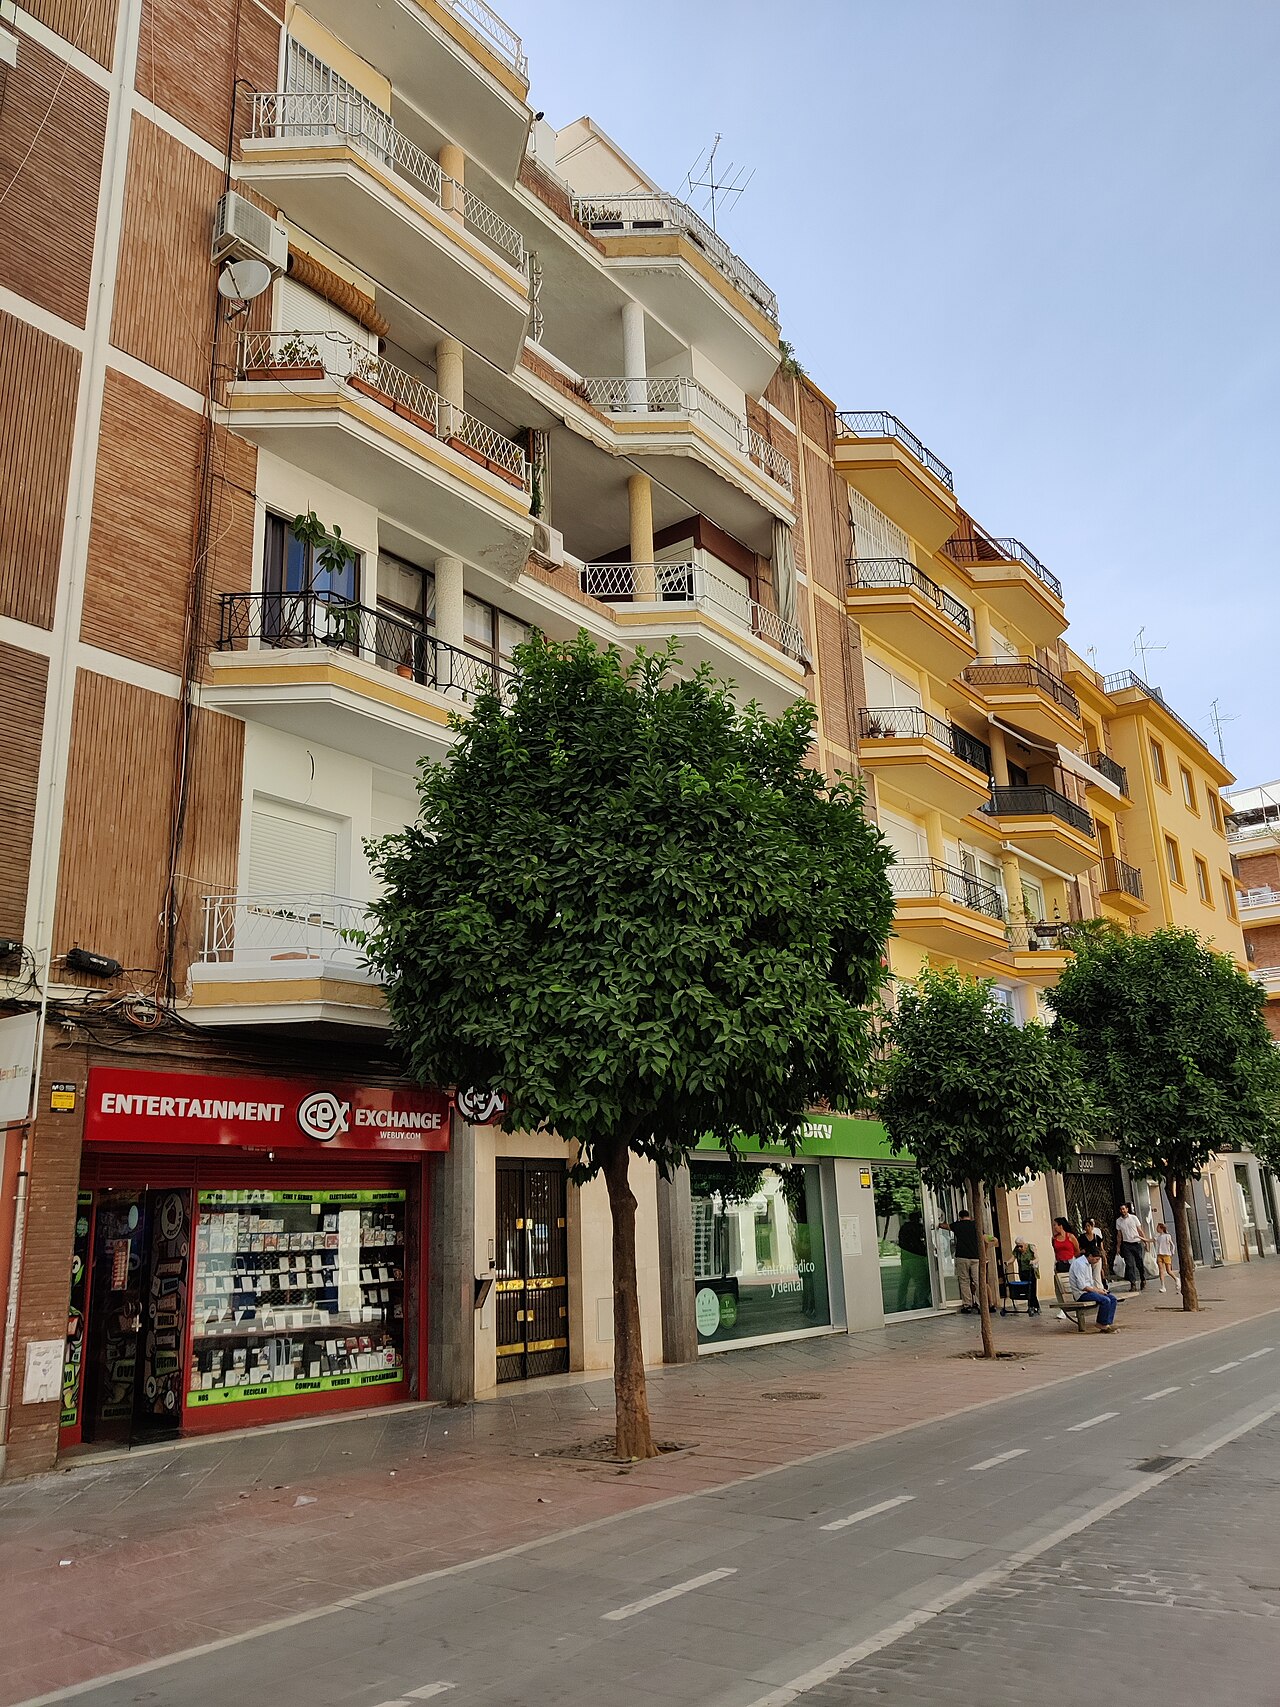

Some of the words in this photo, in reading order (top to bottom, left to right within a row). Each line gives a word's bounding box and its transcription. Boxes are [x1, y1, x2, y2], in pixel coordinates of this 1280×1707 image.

[101, 1093, 284, 1121] ENTERTAINMENT
[355, 1109, 441, 1129] EXCHANGE
[380, 1131, 421, 1140] WEBUY.COM
[803, 1122, 833, 1139] DKV
[757, 1262, 784, 1276] Centro
[786, 1259, 815, 1274] médico
[770, 1283, 777, 1298] y
[778, 1278, 804, 1293] dental
[197, 1394, 209, 1402] NOS
[243, 1387, 268, 1397] RECICLAR
[294, 1380, 321, 1390] COMPRAR
[331, 1378, 351, 1387] VENDER
[360, 1371, 398, 1384] INTERCAMBIAR
